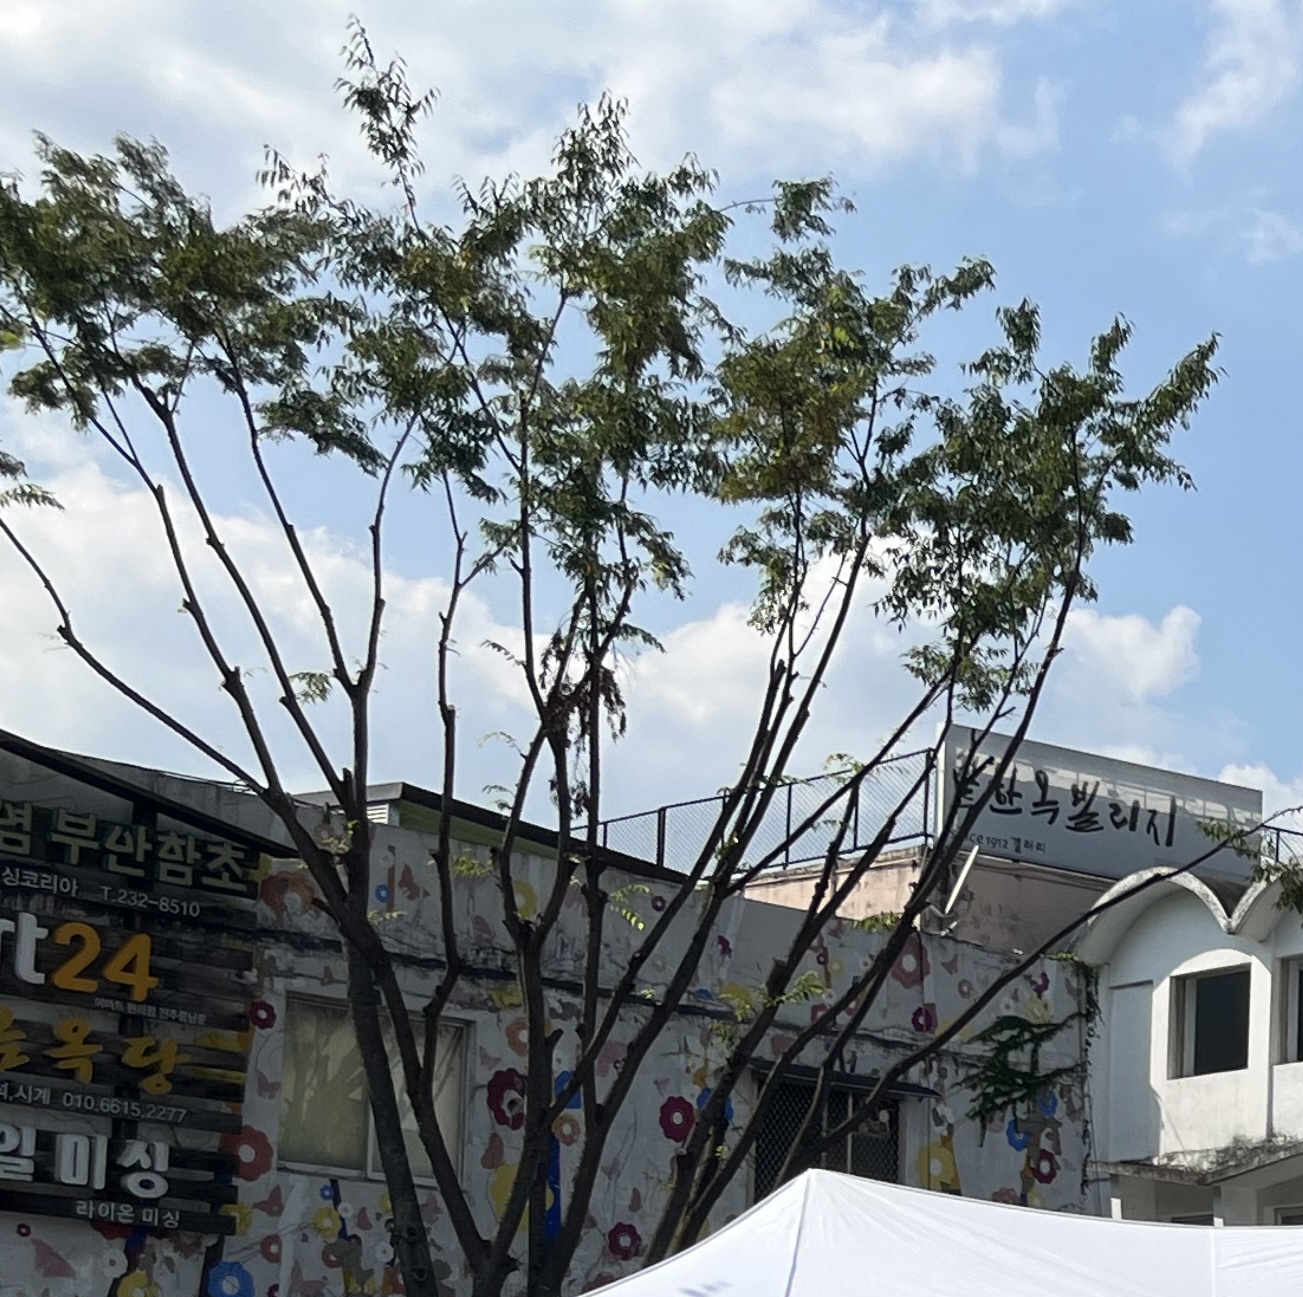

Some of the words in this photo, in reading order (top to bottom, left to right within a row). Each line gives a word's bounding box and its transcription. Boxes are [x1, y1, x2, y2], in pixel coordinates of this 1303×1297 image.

[2, 866, 79, 897] 싱코리아
[101, 886, 200, 918] T.232-8510
[62, 1092, 187, 1123] 010.6615.2277
[75, 1200, 135, 1223] 라이온
[141, 1208, 180, 1228] 미싱
